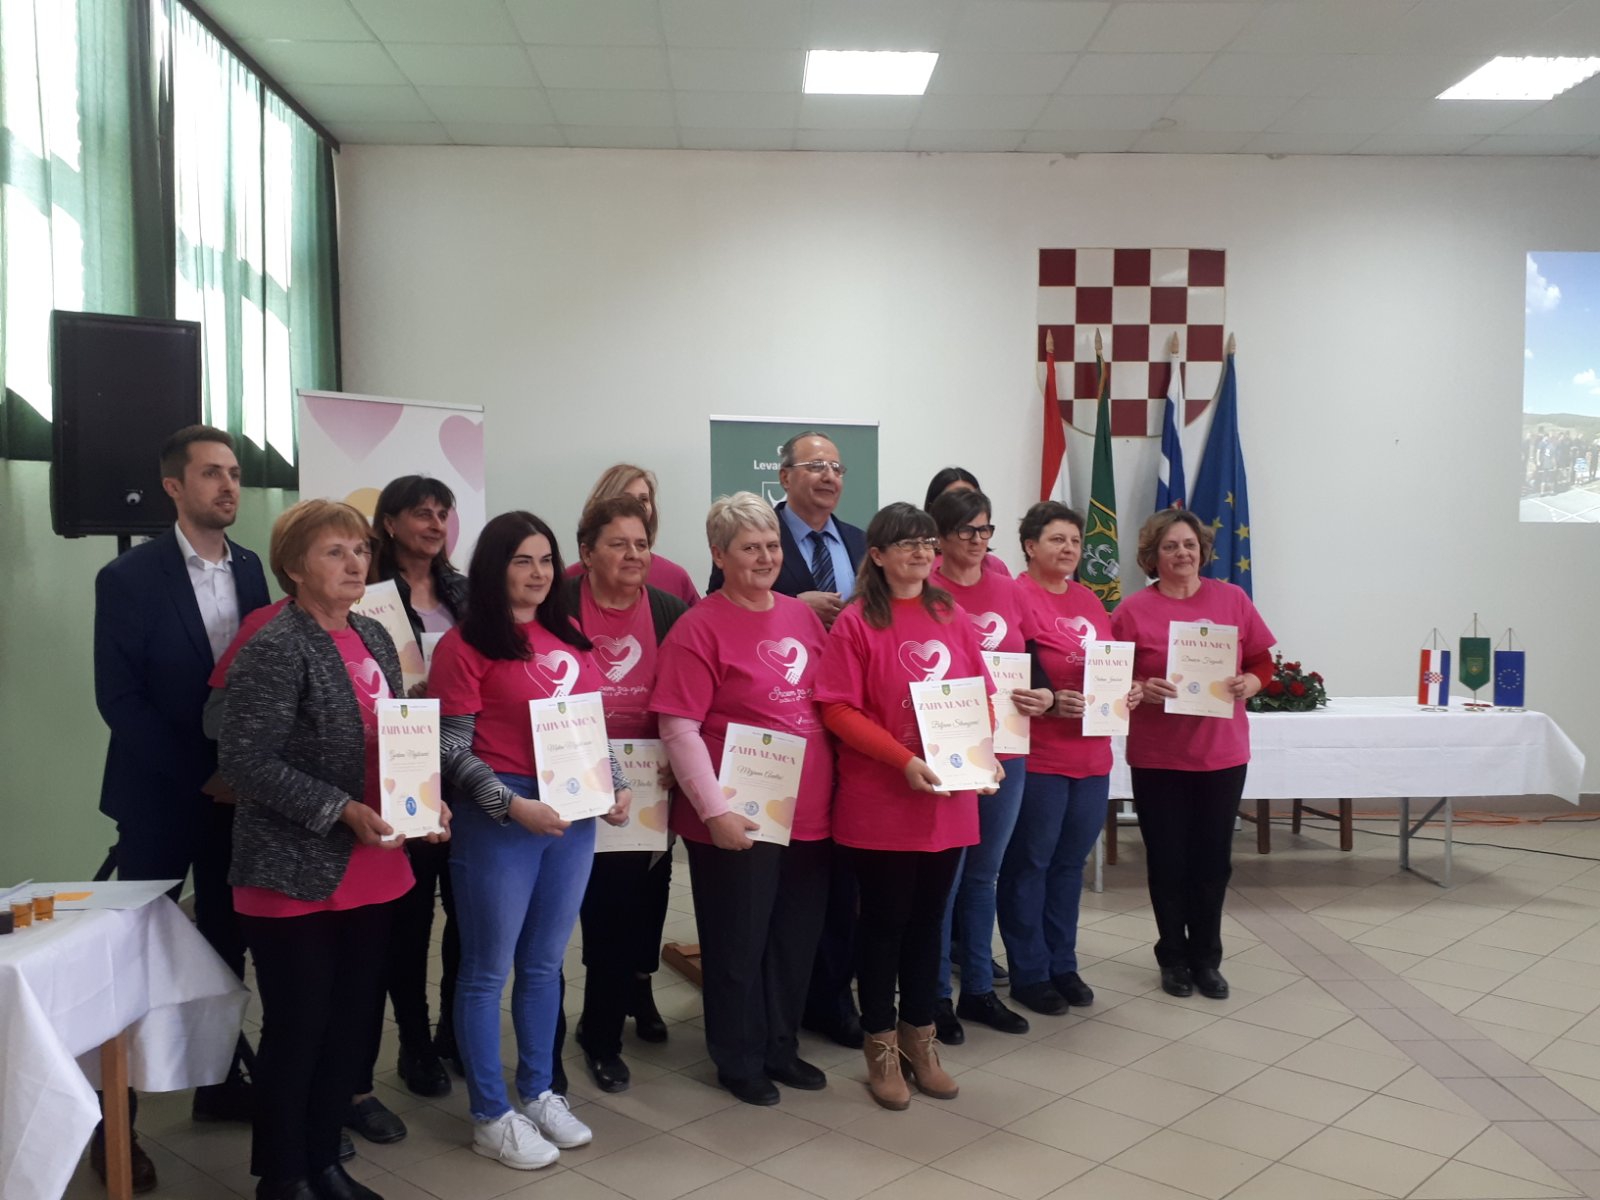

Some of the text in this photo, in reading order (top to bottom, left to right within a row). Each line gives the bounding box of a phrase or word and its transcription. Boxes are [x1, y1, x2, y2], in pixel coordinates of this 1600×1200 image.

[357, 603, 396, 616] LNICA
[1173, 639, 1231, 650] ZAHVALNICA
[1087, 659, 1128, 667] ZAHVALNICA
[993, 671, 1024, 679] ALNICA
[918, 699, 981, 710] ZAHVALNICA
[381, 725, 432, 735] ZAHVALNICA
[535, 716, 598, 733] ZAHVALNICA
[729, 745, 796, 765] ZAHVALNICA
[624, 760, 661, 769] ALNICA
